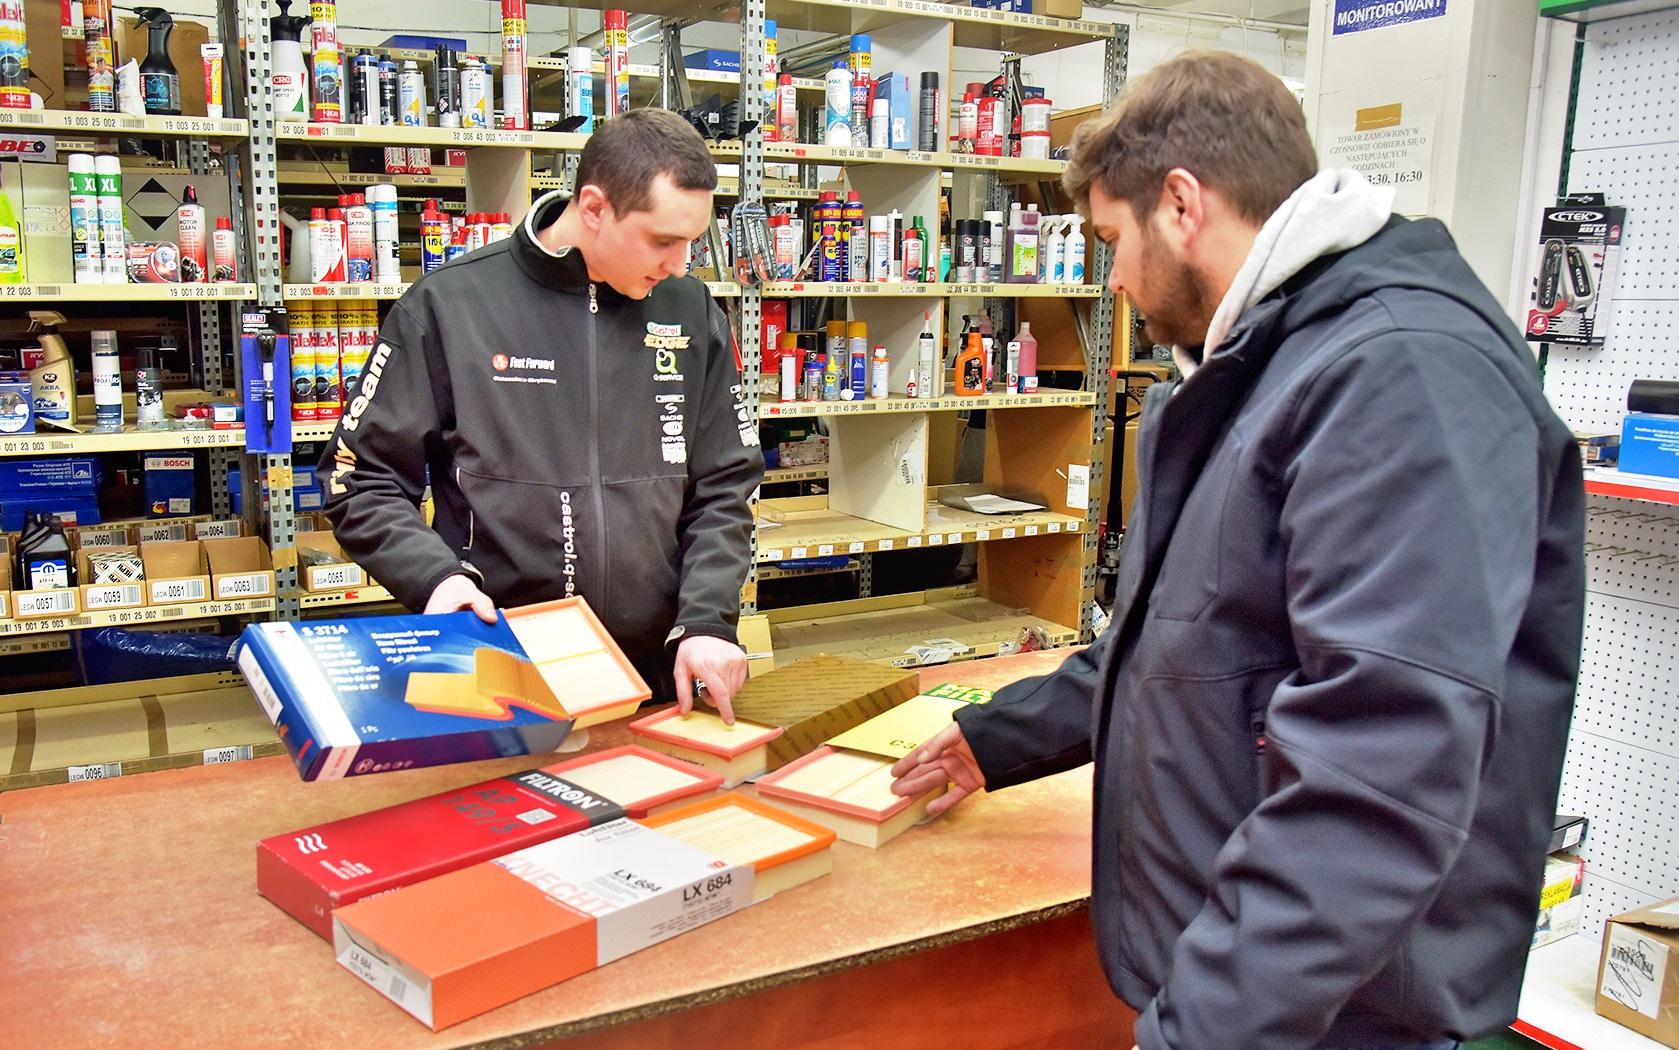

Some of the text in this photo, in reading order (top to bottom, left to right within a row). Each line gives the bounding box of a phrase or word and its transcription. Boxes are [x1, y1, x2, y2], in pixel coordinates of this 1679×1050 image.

[273, 76, 292, 84] CRC
[64, 117, 116, 127] 19 003 25 002
[165, 121, 215, 131] 19 003 25 001
[283, 126, 291, 134] 32
[294, 126, 305, 135] 006
[1338, 134, 1362, 144] TOWAR
[1364, 128, 1411, 141] ZAMÓWIONY
[453, 132, 496, 142] 32 006 43 003
[1330, 143, 1371, 154] CZOSNOWIE
[1373, 140, 1406, 149] ODBIERA
[1407, 138, 1419, 147] SIĘ
[1346, 150, 1407, 162] NASTĘPUJĄCYCH
[1352, 161, 1395, 171] GODZINACH
[1367, 170, 1423, 185] 3:30, 16:30
[84, 179, 96, 191] XL
[102, 179, 117, 192] XL
[1557, 213, 1593, 221] CTEK
[7, 286, 31, 295] 22 003
[170, 288, 218, 297] 19 001 22 001
[290, 287, 297, 296] 32
[300, 287, 311, 296] 003
[374, 287, 381, 295] 32
[384, 287, 394, 295] 003
[644, 334, 691, 349] EDGE
[510, 357, 555, 370] Fast Forward
[342, 343, 392, 431] team
[183, 436, 190, 444] 19
[193, 436, 203, 444] 001
[218, 435, 229, 443] 001
[5, 442, 44, 451] 001 23 003
[154, 531, 169, 541] 0062
[209, 526, 224, 536] 0064
[95, 535, 109, 545] 0060
[328, 572, 344, 584] 0065
[168, 586, 184, 597] 0061
[234, 580, 250, 592] 0063
[104, 592, 121, 603] 0059
[36, 599, 53, 610] 0057
[200, 603, 246, 614] 19 001 25 001
[109, 611, 156, 622] 19 001 25 002
[14, 620, 64, 632] 19 001 25 003
[301, 625, 348, 636] S 3714
[219, 750, 235, 762] 0097
[85, 767, 102, 780] 0096
[519, 772, 602, 809] FILTRON
[472, 789, 519, 804] AP
[441, 795, 525, 834] 149/5
[580, 820, 628, 838] Luftfilter
[596, 825, 642, 843] Air filter
[500, 855, 621, 914] KNECHT
[614, 869, 634, 881] LX
[635, 879, 662, 892] 684
[683, 873, 732, 901] LX 684
[350, 950, 360, 960] LX
